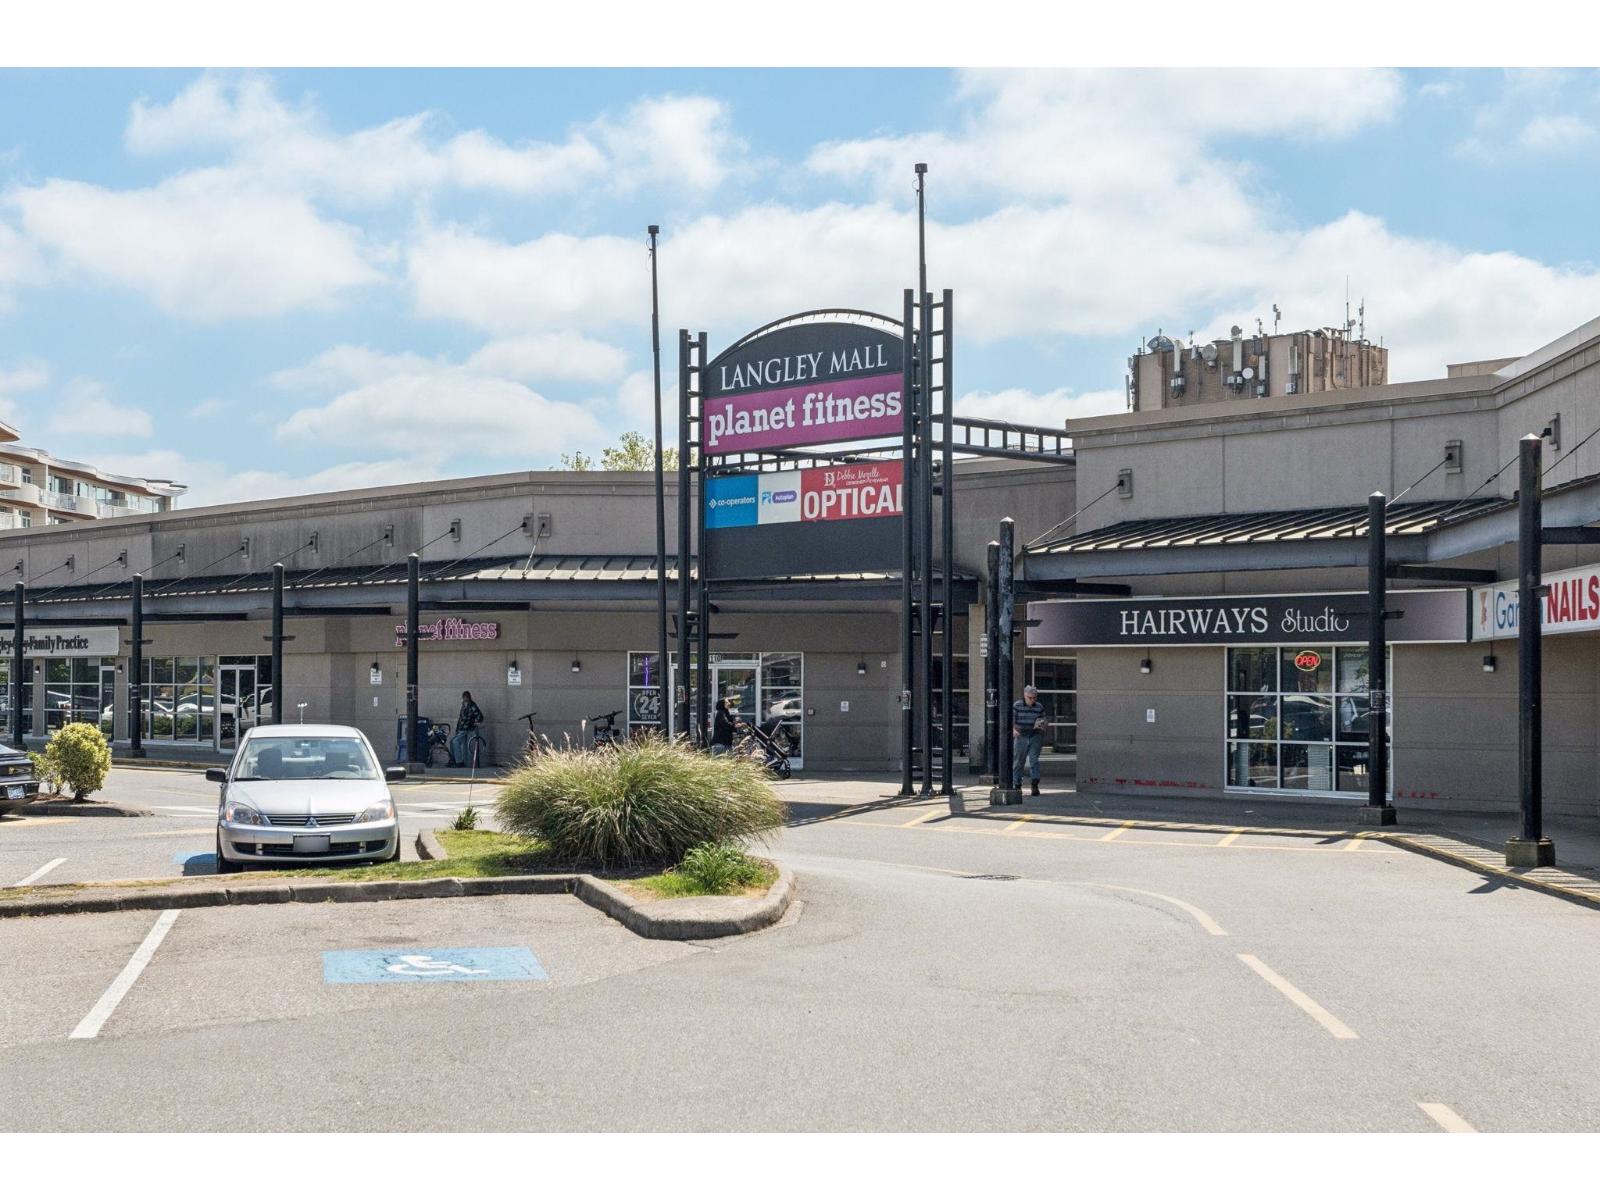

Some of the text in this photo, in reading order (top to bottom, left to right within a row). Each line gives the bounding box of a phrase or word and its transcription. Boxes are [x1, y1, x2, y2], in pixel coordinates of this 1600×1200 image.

[720, 344, 888, 391] LANGLEY MALL
[709, 391, 902, 446] planet fitness
[717, 496, 756, 508] co-operators
[1547, 575, 1600, 624] NAILS
[444, 617, 498, 640] fitness
[1119, 607, 1269, 635] HAIRWAYS
[55, 634, 89, 650] Practice
[1295, 655, 1318, 667] OPEN
[640, 697, 660, 713] 24
